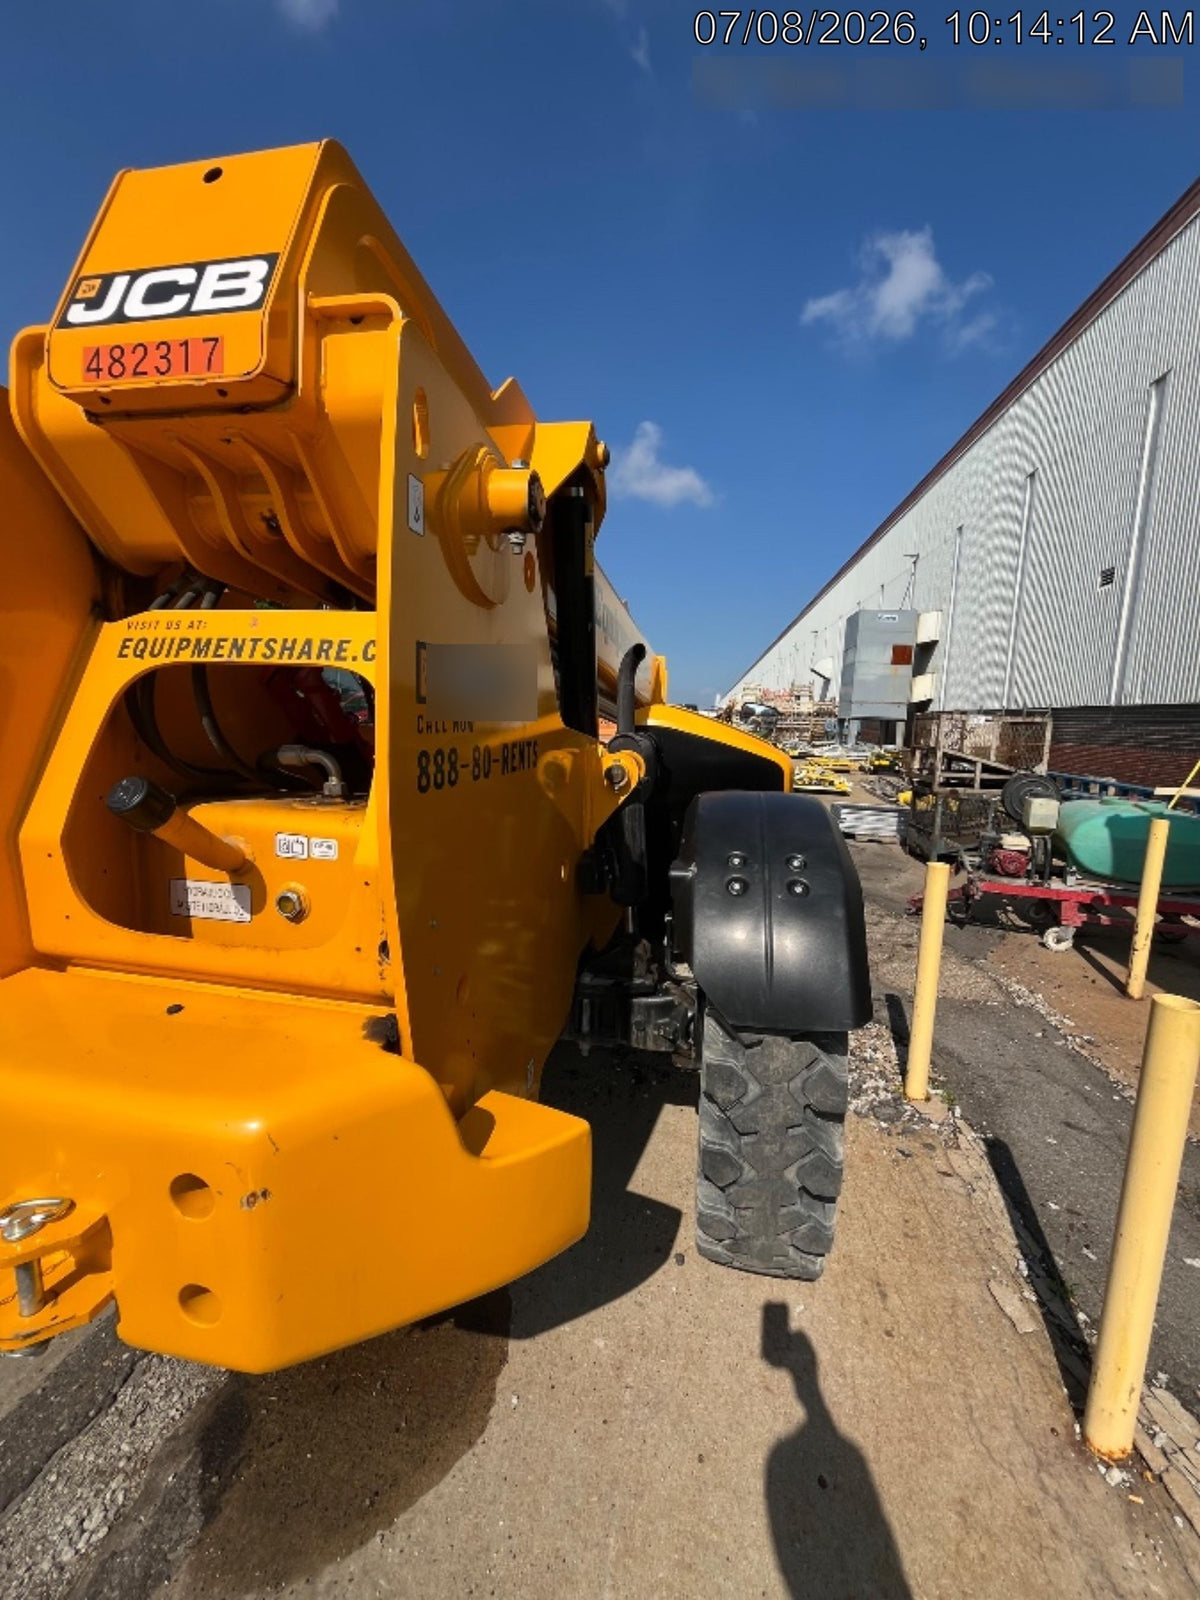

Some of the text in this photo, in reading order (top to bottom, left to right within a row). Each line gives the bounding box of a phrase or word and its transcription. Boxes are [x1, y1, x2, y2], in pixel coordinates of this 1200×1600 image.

[67, 259, 269, 324] JCB
[86, 337, 219, 379] 482317
[127, 620, 207, 631] VISIT US AT:
[117, 637, 377, 662] EQUIPMENTSHARE.C
[417, 740, 538, 794] 888-80-RENTS
